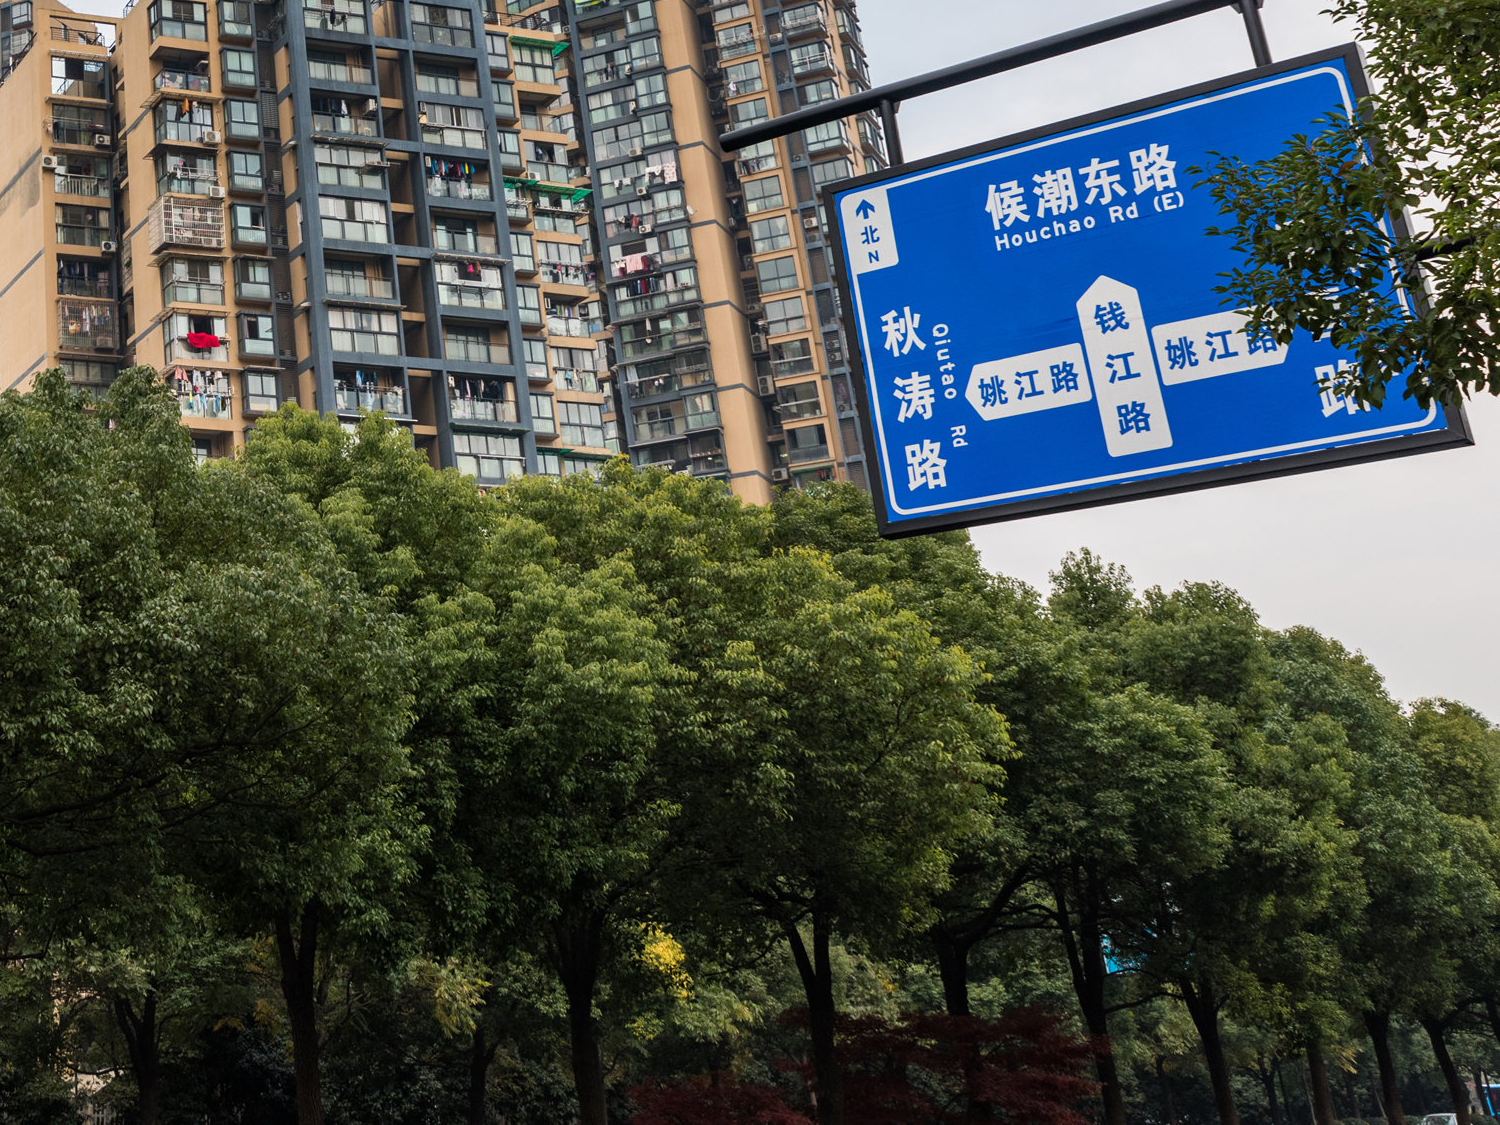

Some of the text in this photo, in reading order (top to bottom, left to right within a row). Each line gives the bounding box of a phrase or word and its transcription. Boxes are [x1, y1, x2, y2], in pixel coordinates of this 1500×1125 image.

[985, 143, 1177, 231] 候潮东路
[994, 191, 1185, 252] Houchao Rd (E)
[860, 224, 881, 245] 北
[867, 249, 880, 264] N
[880, 305, 947, 492] 秋涛路
[932, 323, 969, 448] Qiutao Rd
[977, 360, 1080, 408] 姚江路
[1093, 301, 1152, 436] 钱江路
